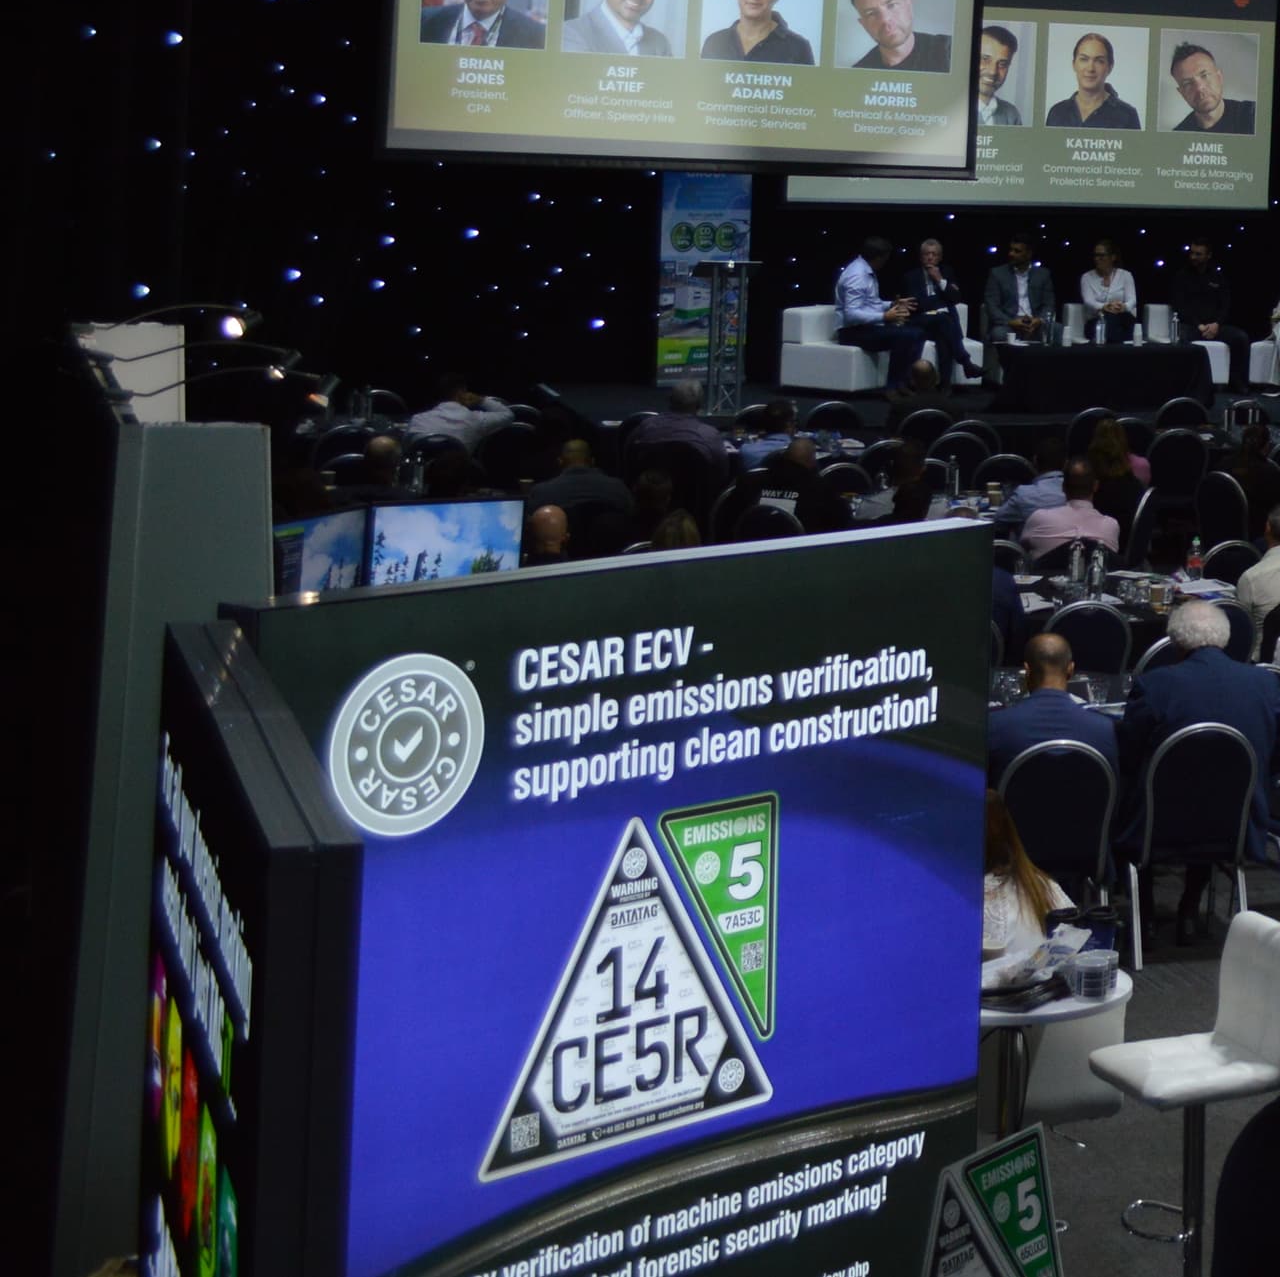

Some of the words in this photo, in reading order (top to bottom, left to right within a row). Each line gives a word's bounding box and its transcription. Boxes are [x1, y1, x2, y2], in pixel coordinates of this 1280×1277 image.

[459, 57, 504, 71] BRIAN
[457, 73, 504, 85] JONES
[606, 66, 638, 78] ASIF
[599, 80, 645, 93] LATIEF
[725, 73, 792, 87] KATHRYN
[732, 88, 784, 100] ADAMS
[871, 81, 912, 94] JAMIE
[568, 94, 598, 105] Chief
[602, 95, 673, 109] Commercial
[697, 101, 767, 115] Commercial
[864, 95, 917, 108] MORRIS
[833, 108, 882, 120] Technical
[895, 112, 947, 125] Managing
[761, 118, 806, 130] Services
[1066, 138, 1122, 150] KATHRYN
[1188, 143, 1223, 153] JAMIE
[1072, 151, 1115, 162] ADAMS
[1183, 155, 1227, 165] MORRIS
[1043, 164, 1101, 174] Commercial
[1157, 168, 1198, 177] Technical
[1208, 170, 1253, 181] Managing
[1097, 178, 1135, 188] Services
[762, 489, 781, 498] WAY
[784, 491, 799, 499] UP
[518, 635, 625, 691] CESAR
[634, 626, 695, 674] ECV
[515, 691, 619, 746] simple
[629, 673, 773, 727] emissions
[782, 645, 934, 699] verification,
[359, 678, 457, 732] CESAR
[514, 738, 675, 803] supporting
[685, 725, 761, 769] clean
[770, 686, 939, 752] construction!
[358, 757, 456, 811] CESAR
[728, 840, 764, 900] 5
[611, 877, 658, 898] WARNING
[611, 904, 658, 926] DATATAG
[725, 909, 761, 930] 7A53C
[596, 936, 669, 1024] 14
[552, 1005, 709, 1114] CE5R
[502, 1228, 624, 1277] verification
[631, 1215, 651, 1246] of
[655, 1190, 743, 1240] machine
[748, 1162, 843, 1211] emissions
[848, 1130, 926, 1181] category
[1017, 1176, 1042, 1232] 5
[638, 1239, 720, 1277] forensic
[726, 1209, 803, 1257] security
[807, 1175, 887, 1229] marking!
